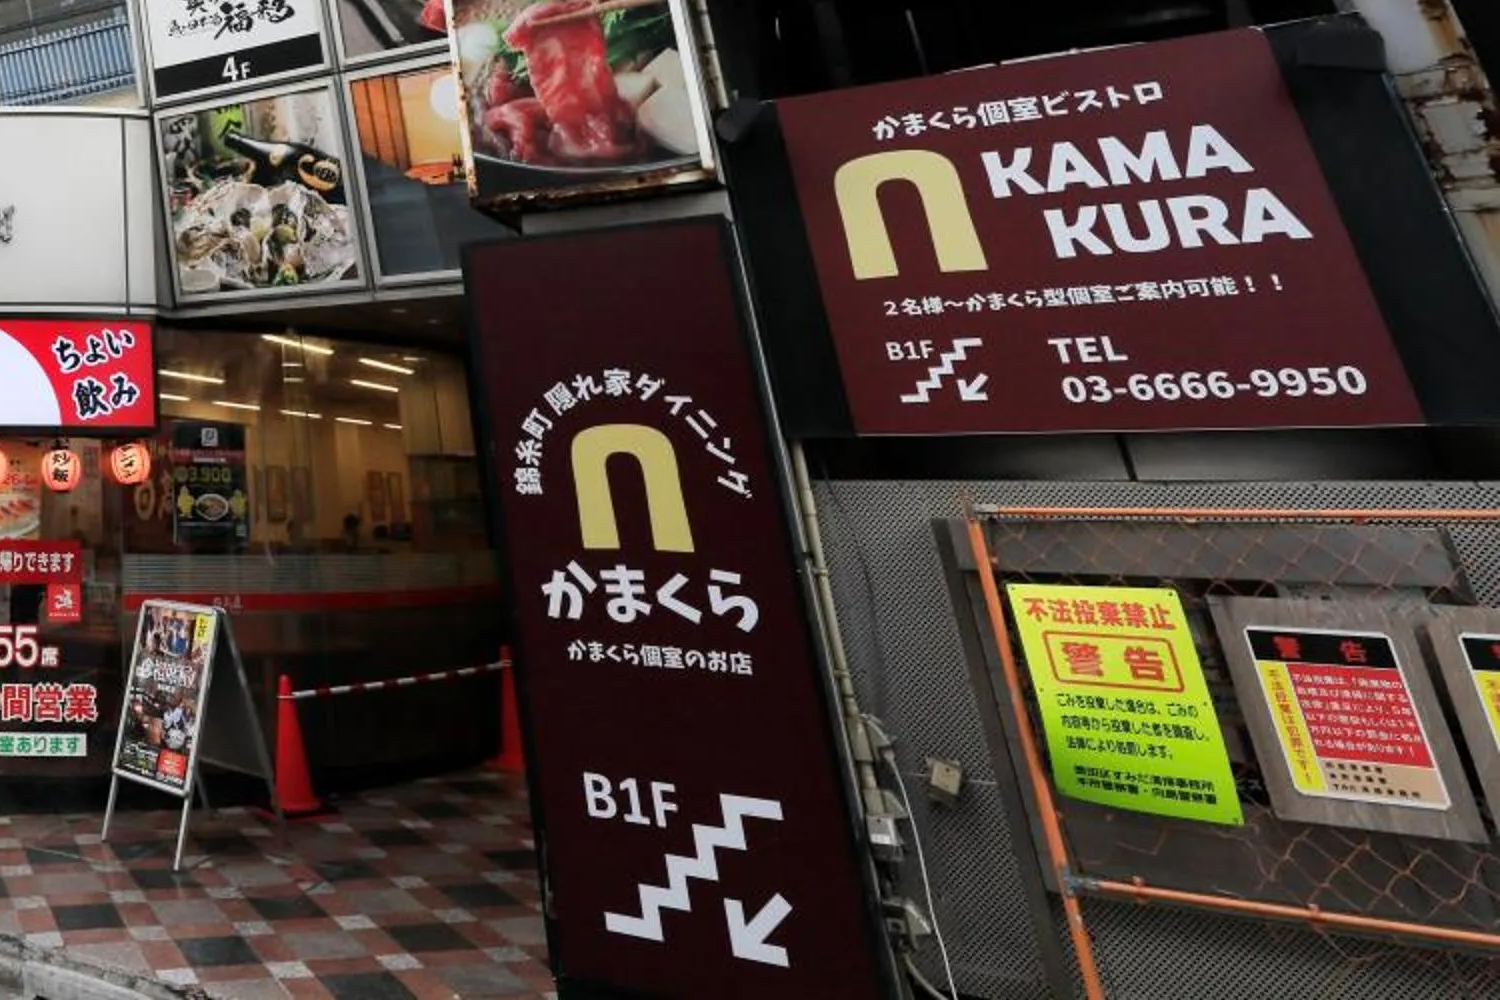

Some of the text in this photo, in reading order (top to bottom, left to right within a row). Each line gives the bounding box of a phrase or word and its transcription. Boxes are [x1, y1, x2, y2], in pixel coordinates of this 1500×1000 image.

[222, 57, 251, 81] 4F
[872, 80, 1165, 140] かまくら個室ビストロ
[982, 123, 1255, 199] KAMA
[1042, 187, 1314, 259] KURA
[54, 328, 135, 373] ちょい
[886, 339, 934, 363] B1F
[1047, 335, 1128, 366] TEL
[74, 373, 140, 418] 飲み
[1062, 365, 1368, 403] 03-6666-9950
[540, 560, 761, 633] かまくら
[1023, 597, 1176, 631] 不法投棄禁止
[567, 640, 754, 675] かまくら個室のお店
[1061, 641, 1166, 683] 警告
[582, 772, 679, 829] B1F
